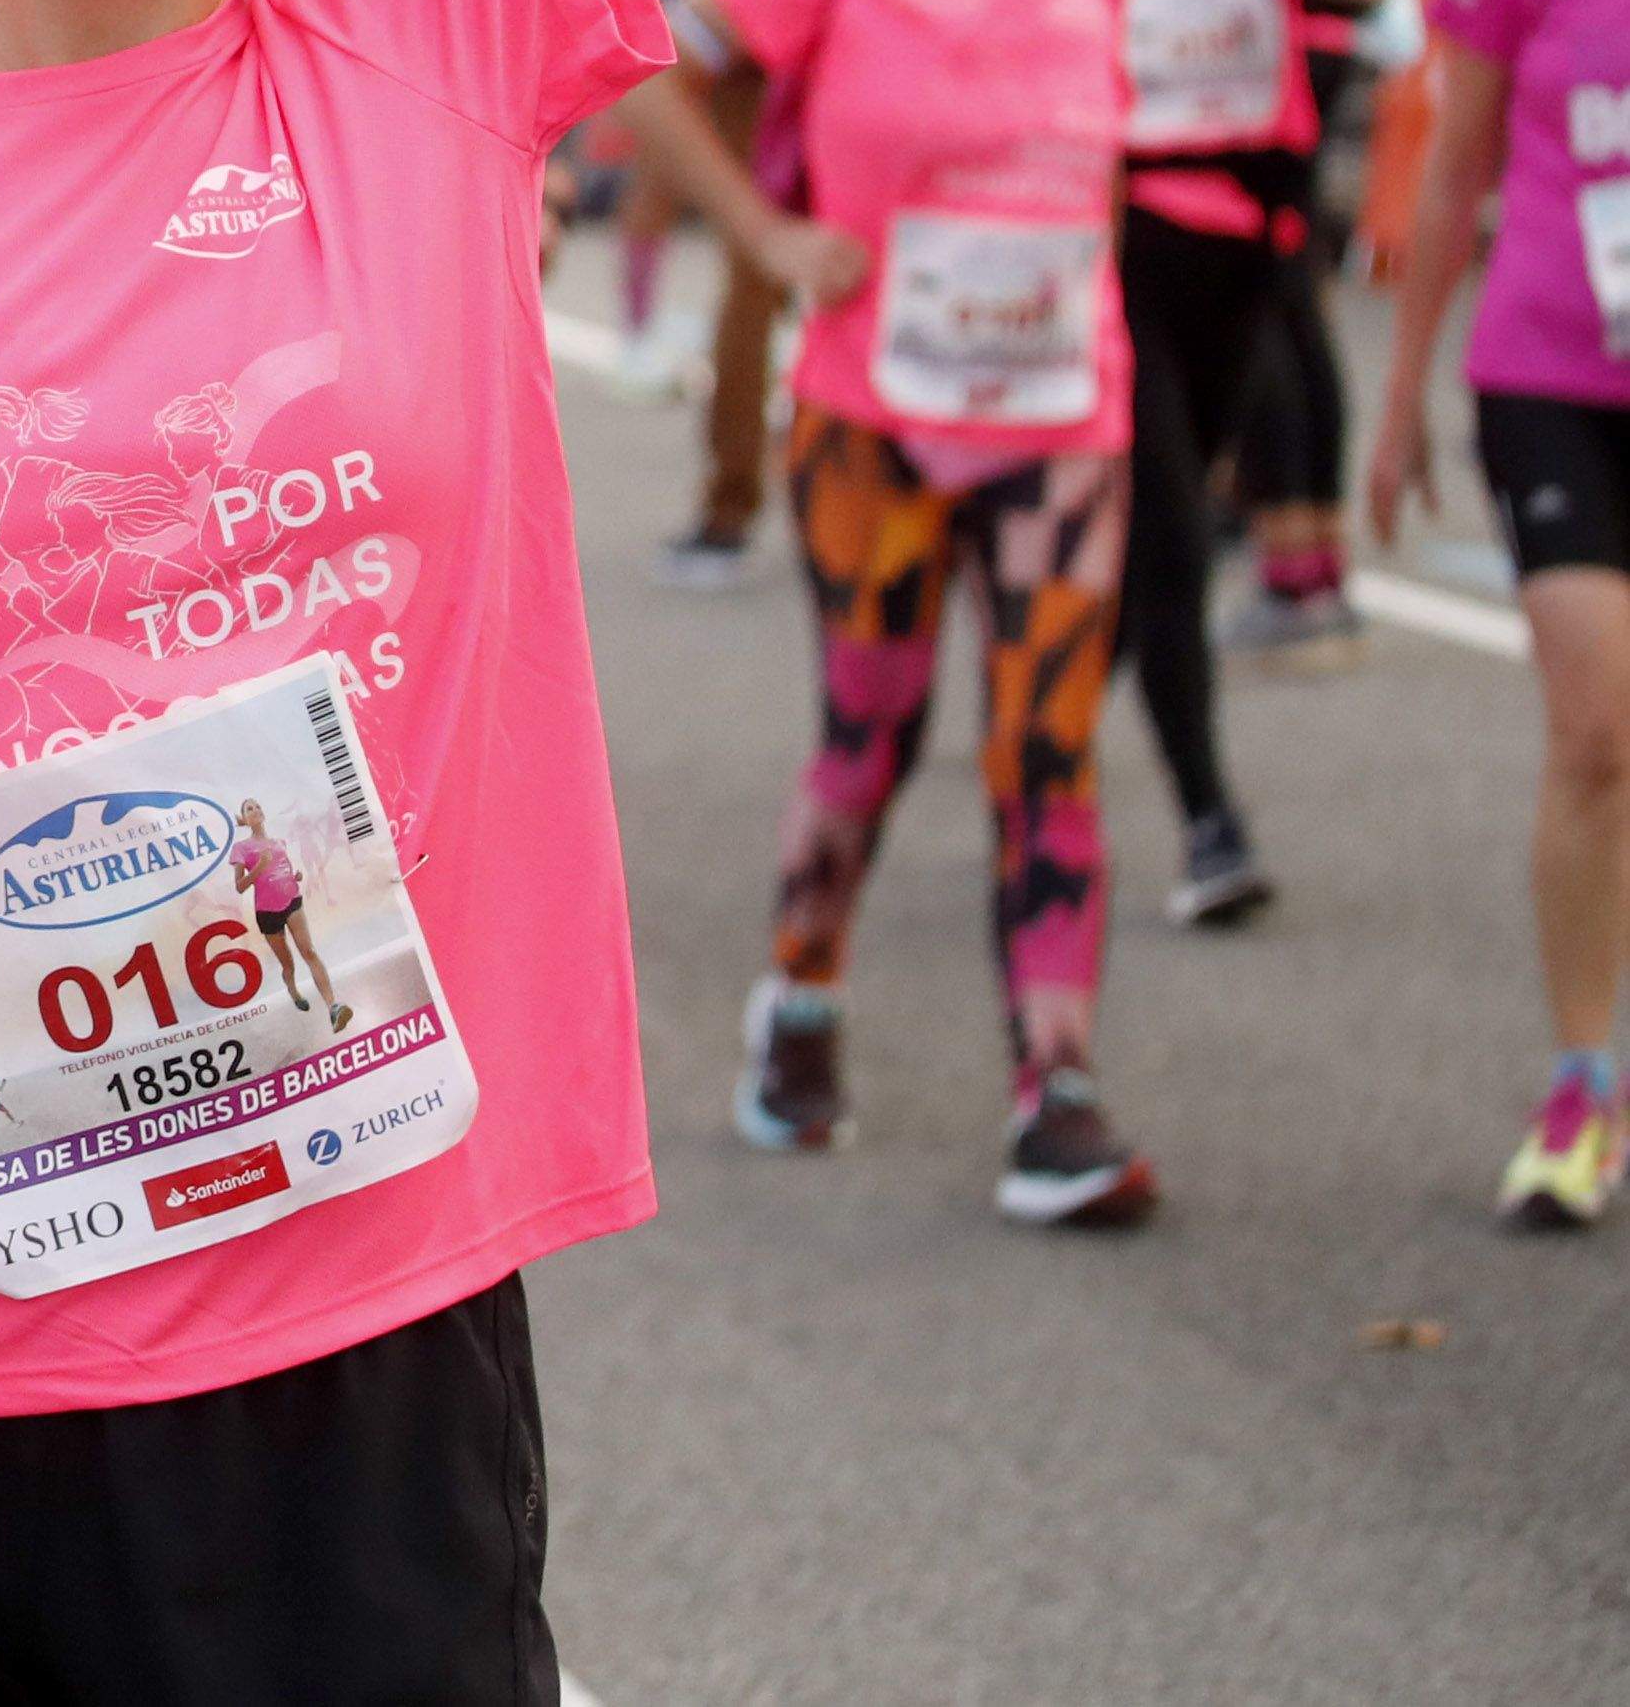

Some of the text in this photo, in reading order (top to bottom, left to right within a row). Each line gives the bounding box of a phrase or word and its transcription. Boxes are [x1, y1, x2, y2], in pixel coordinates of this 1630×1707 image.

[213, 449, 383, 548] POR
[126, 538, 394, 662] TODAS
[3, 824, 220, 916] ASTURIANA
[27, 808, 199, 869] CENTRAL LECHERA
[38, 919, 263, 1053] 016
[59, 1004, 268, 1076] TELÉFONO VIOLENCIA DE GÉNERO
[107, 1039, 252, 1113] 18582
[36, 1142, 75, 1176] DE
[81, 1125, 134, 1163] LES
[139, 1095, 234, 1145] DONES
[240, 1079, 278, 1108] DE
[283, 1013, 437, 1098] BARCELONA
[352, 1088, 445, 1145] ZURICH
[186, 1165, 268, 1203] Santander
